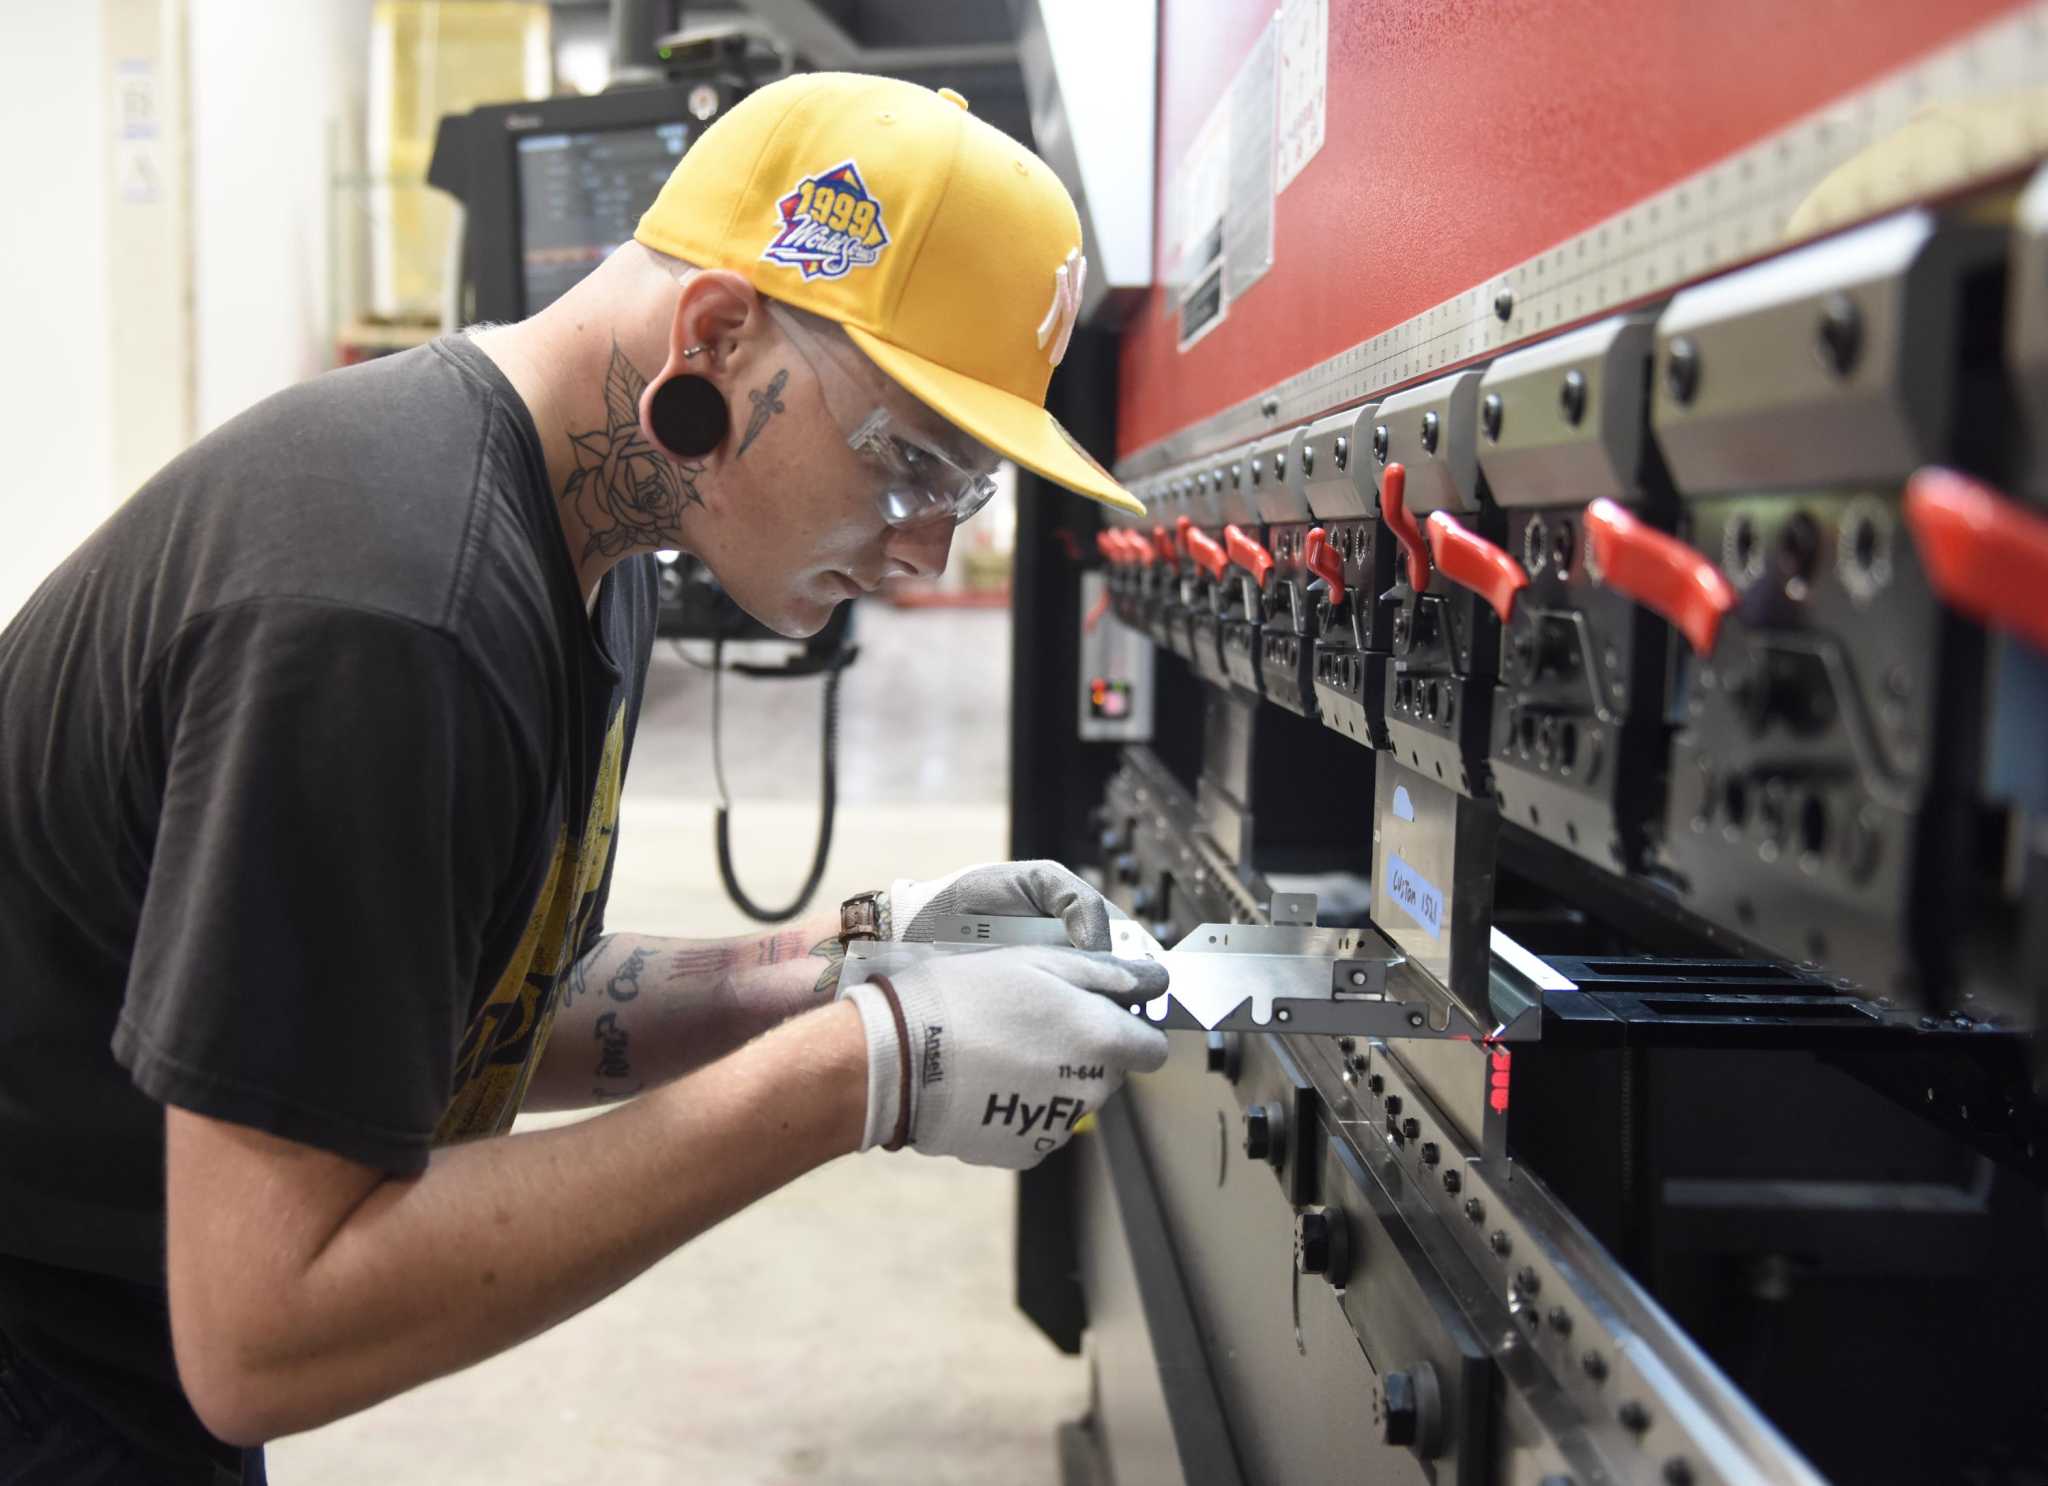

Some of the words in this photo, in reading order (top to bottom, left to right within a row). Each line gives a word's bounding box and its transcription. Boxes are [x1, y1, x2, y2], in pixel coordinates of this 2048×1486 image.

[796, 179, 875, 240] 1999
[925, 1025, 943, 1084] Ansell
[1058, 1065, 1104, 1081] 11-644
